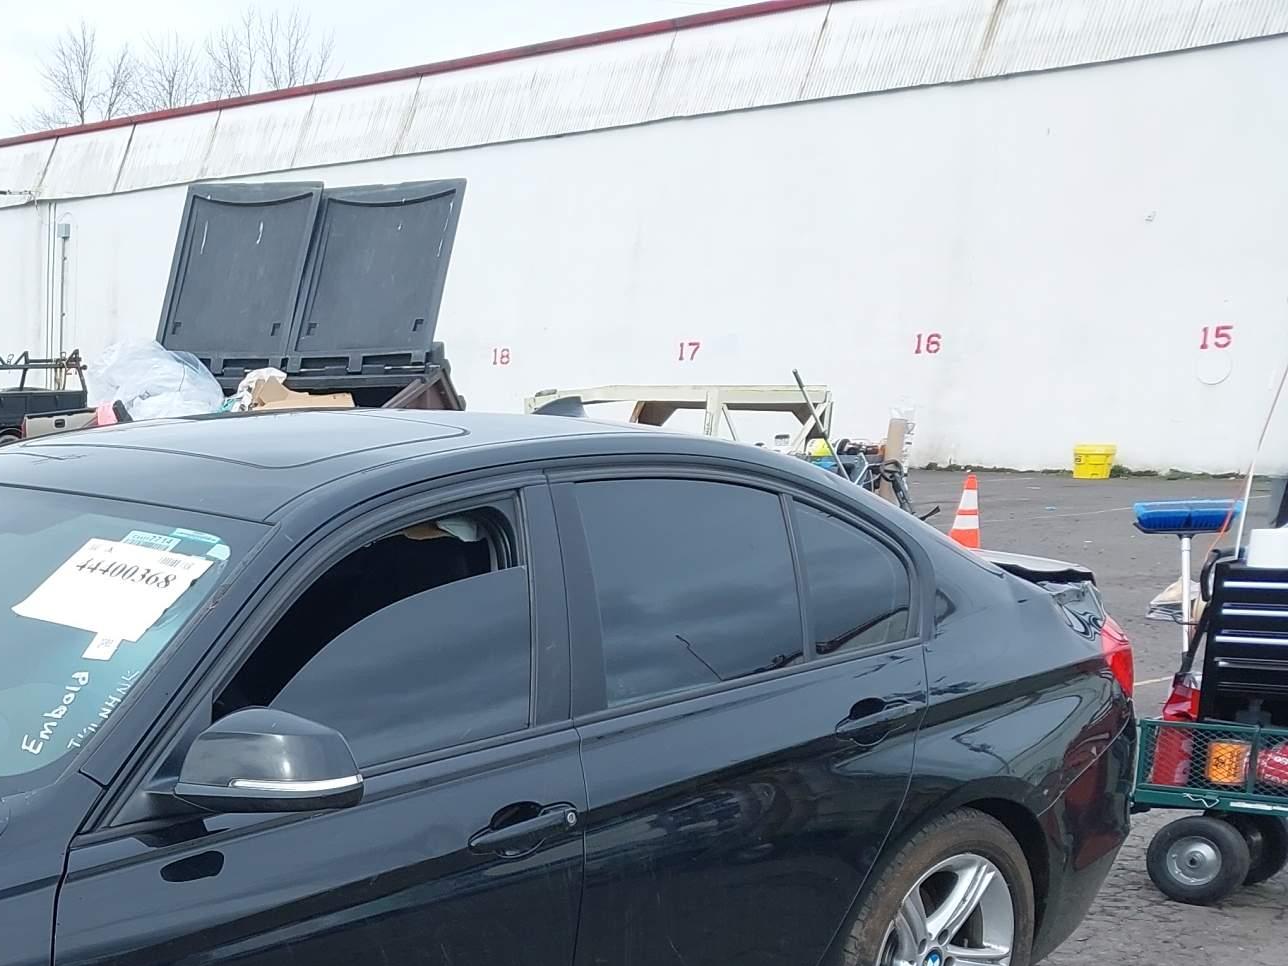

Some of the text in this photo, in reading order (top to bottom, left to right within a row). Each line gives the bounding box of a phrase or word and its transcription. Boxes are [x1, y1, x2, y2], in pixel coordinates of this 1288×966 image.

[914, 333, 943, 354] 16
[1199, 324, 1234, 350] 15
[492, 348, 511, 366] 18
[678, 341, 701, 361] 17
[76, 557, 177, 589] 44400368
[21, 671, 89, 755] Embold
